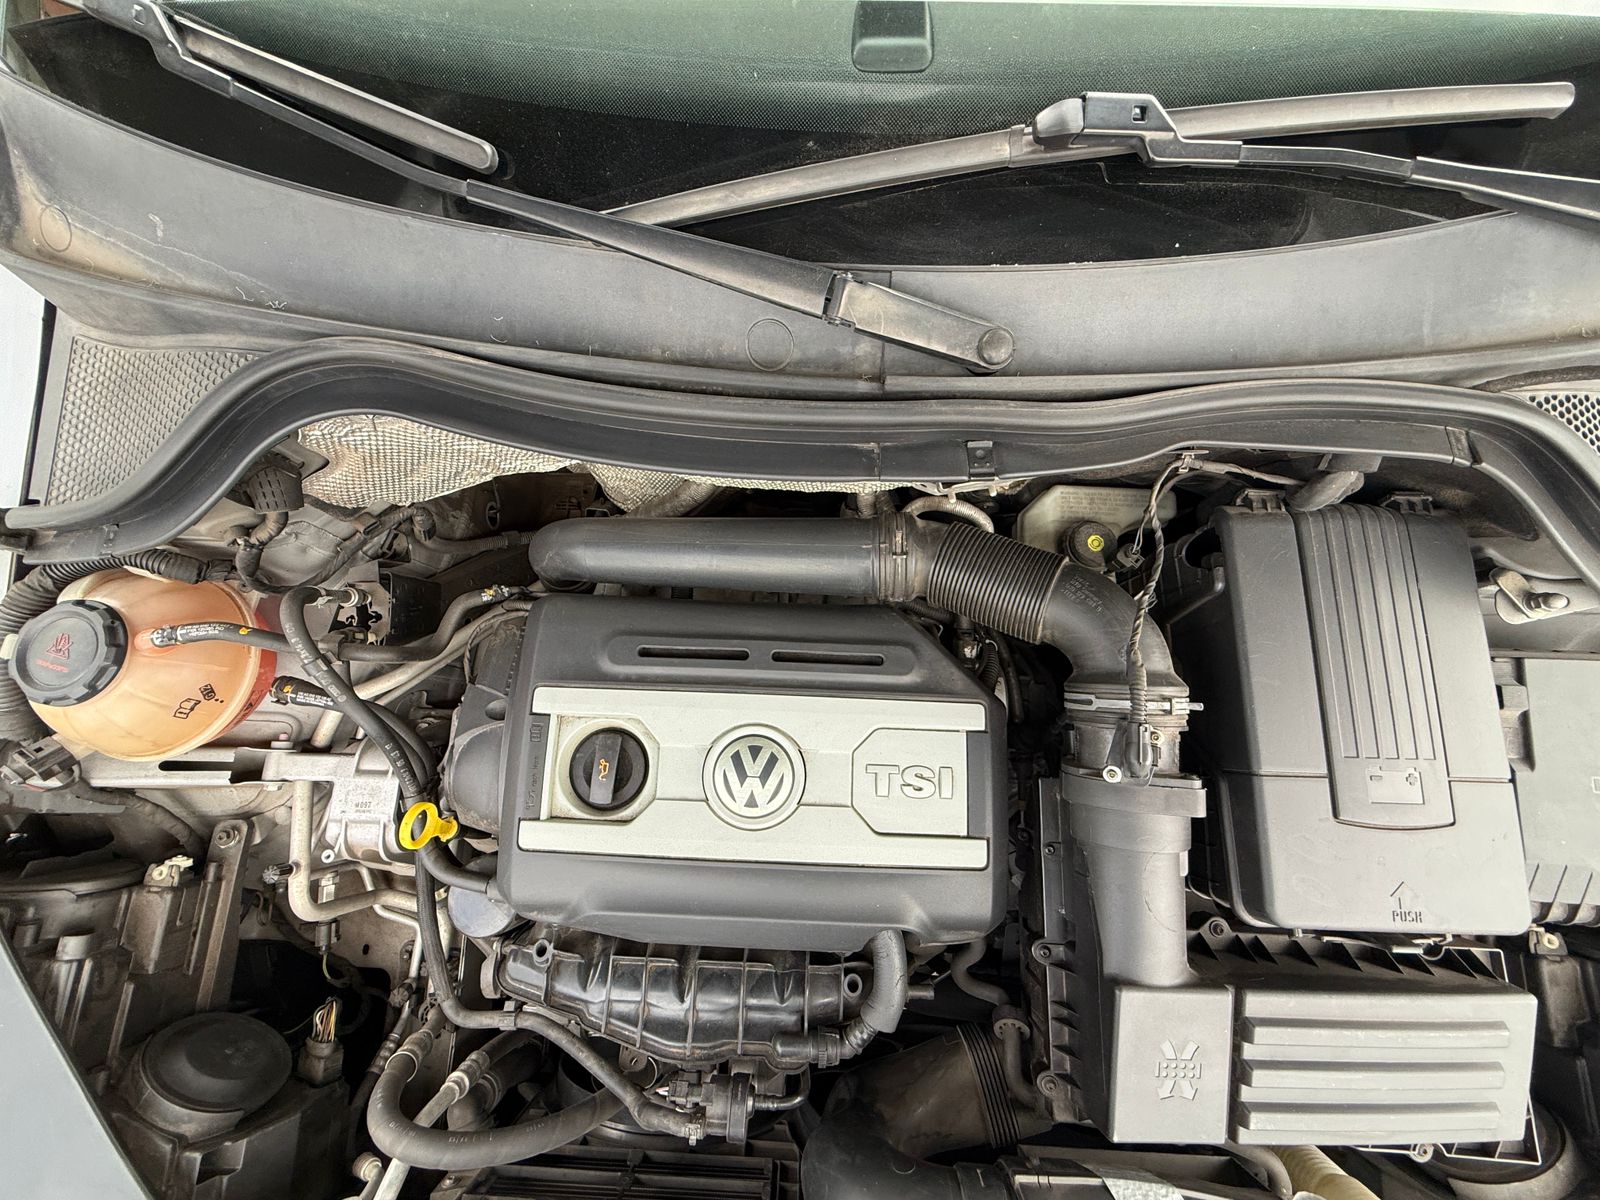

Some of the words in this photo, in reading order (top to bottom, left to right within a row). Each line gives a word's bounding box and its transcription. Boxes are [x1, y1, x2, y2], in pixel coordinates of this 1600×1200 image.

[714, 734, 795, 819] VW
[865, 763, 954, 800] TSI
[1392, 910, 1423, 923] PUSH
